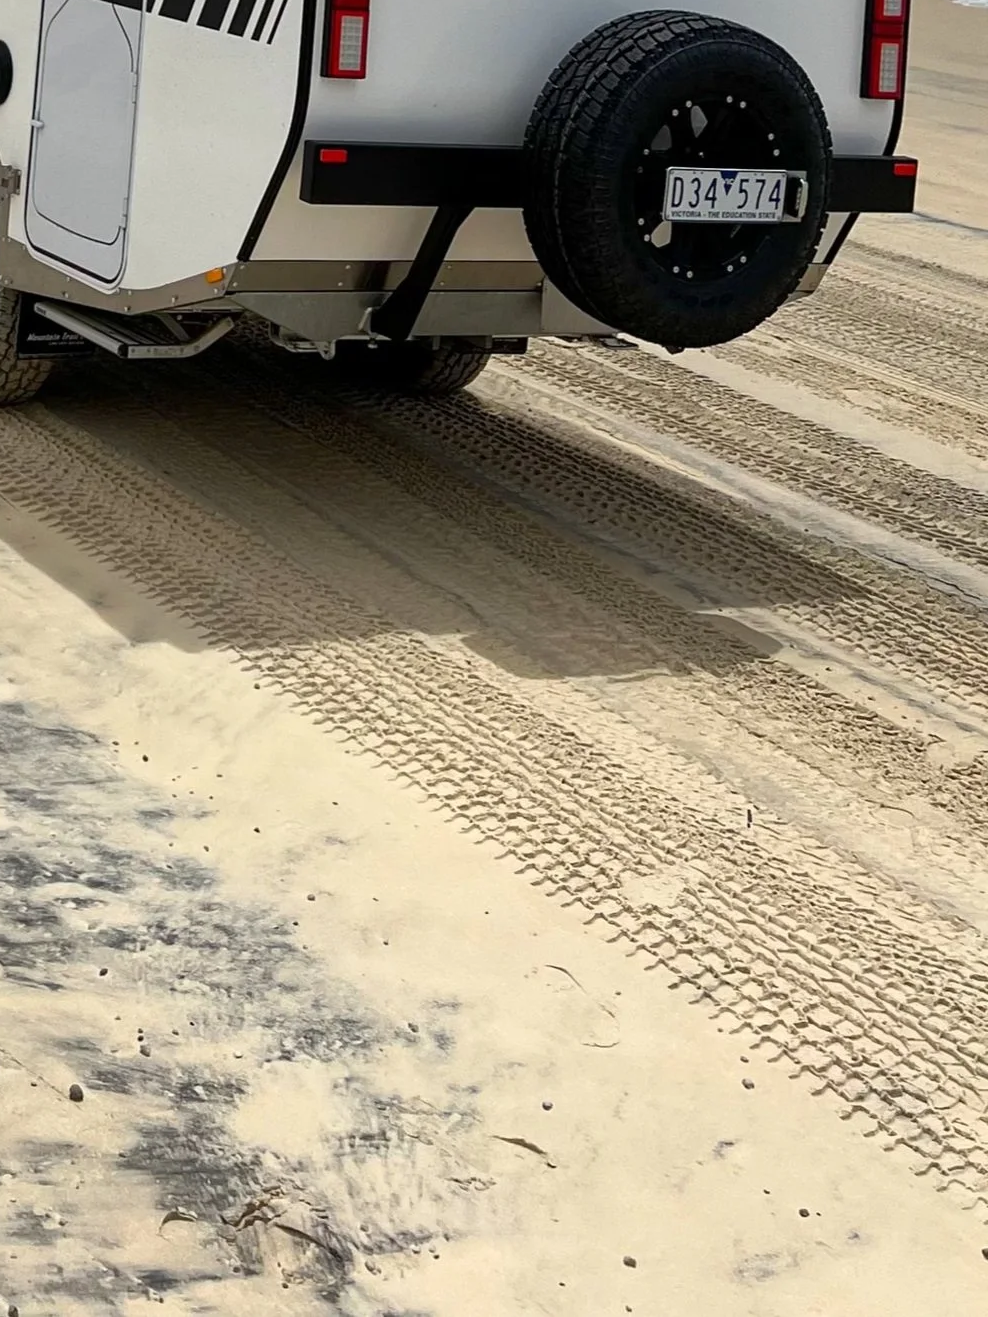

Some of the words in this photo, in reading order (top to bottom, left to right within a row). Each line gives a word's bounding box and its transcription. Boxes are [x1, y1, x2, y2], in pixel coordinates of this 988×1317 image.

[670, 176, 718, 209] D34
[737, 178, 781, 210] 574
[671, 210, 702, 218] VICTORIA
[708, 211, 720, 219] THE
[721, 211, 757, 219] EDUCATION
[758, 211, 776, 219] STATE
